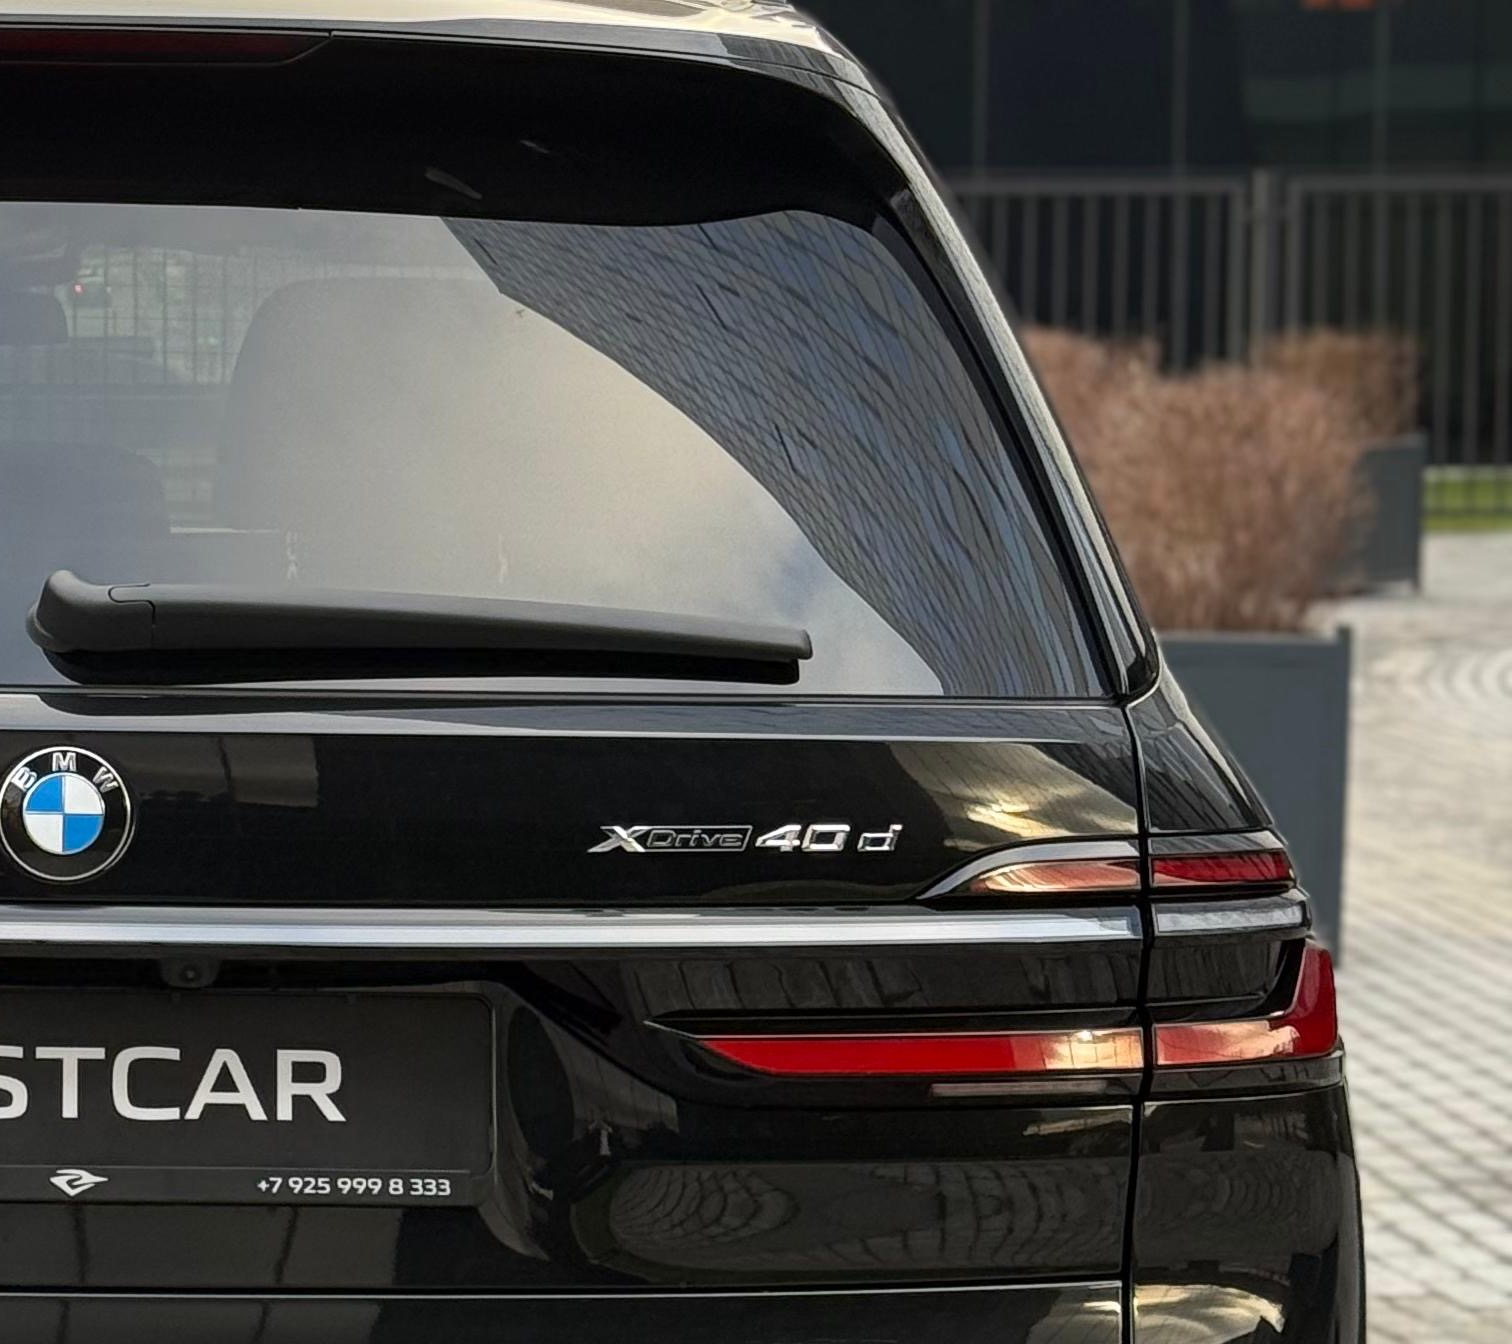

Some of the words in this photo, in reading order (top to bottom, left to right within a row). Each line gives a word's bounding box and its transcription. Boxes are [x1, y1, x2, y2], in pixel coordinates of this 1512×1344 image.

[11, 751, 120, 793] BMW
[257, 1176, 283, 1194] +7
[288, 1176, 331, 1195] 925
[337, 1177, 383, 1195] 999
[388, 1177, 404, 1195] 8
[409, 1178, 451, 1196] 333
